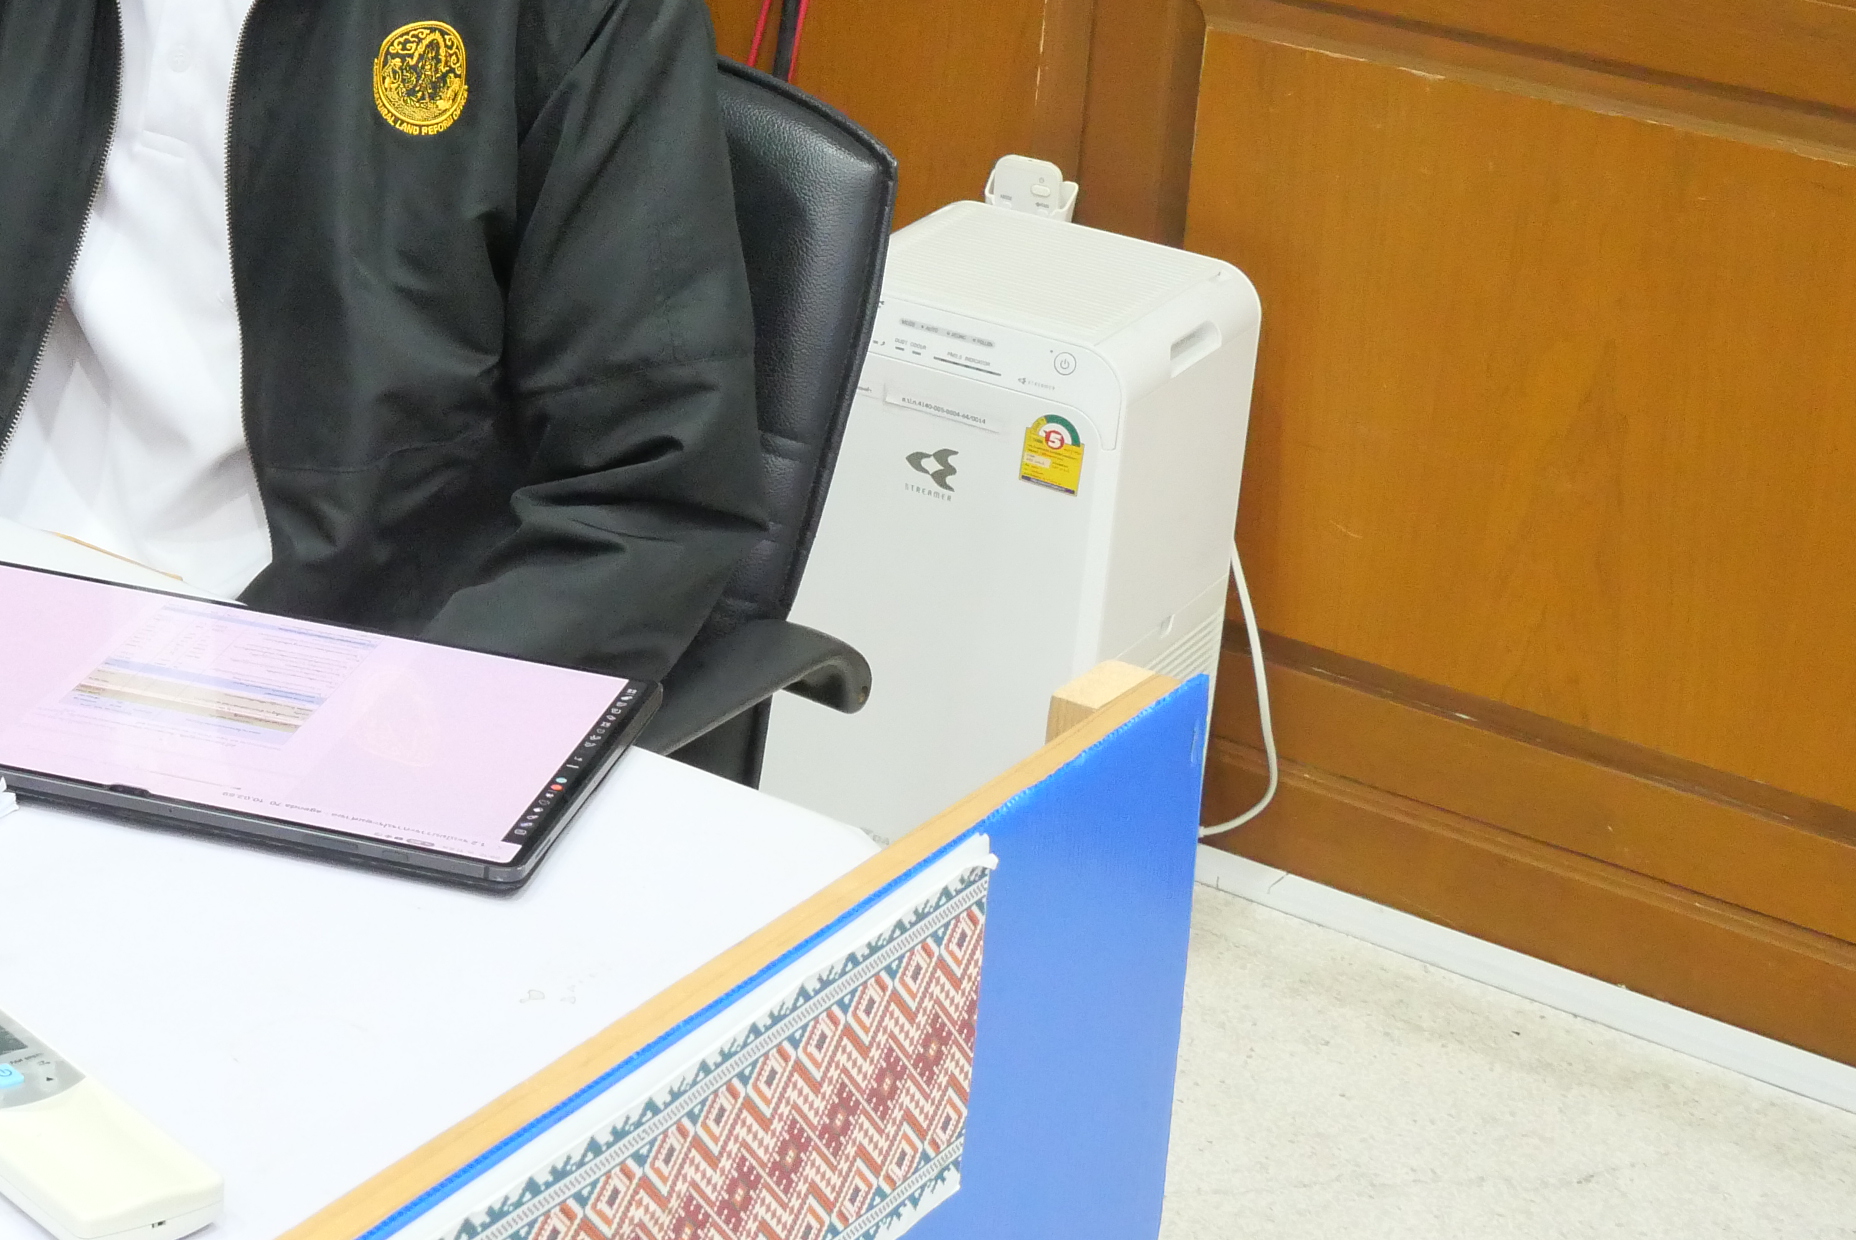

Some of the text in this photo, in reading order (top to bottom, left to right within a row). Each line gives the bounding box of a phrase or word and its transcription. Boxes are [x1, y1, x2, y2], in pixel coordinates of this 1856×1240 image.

[395, 120, 420, 135] LAND
[422, 116, 454, 135] REFORM
[1047, 432, 1062, 449] 5
[904, 482, 952, 503] STREAMER
